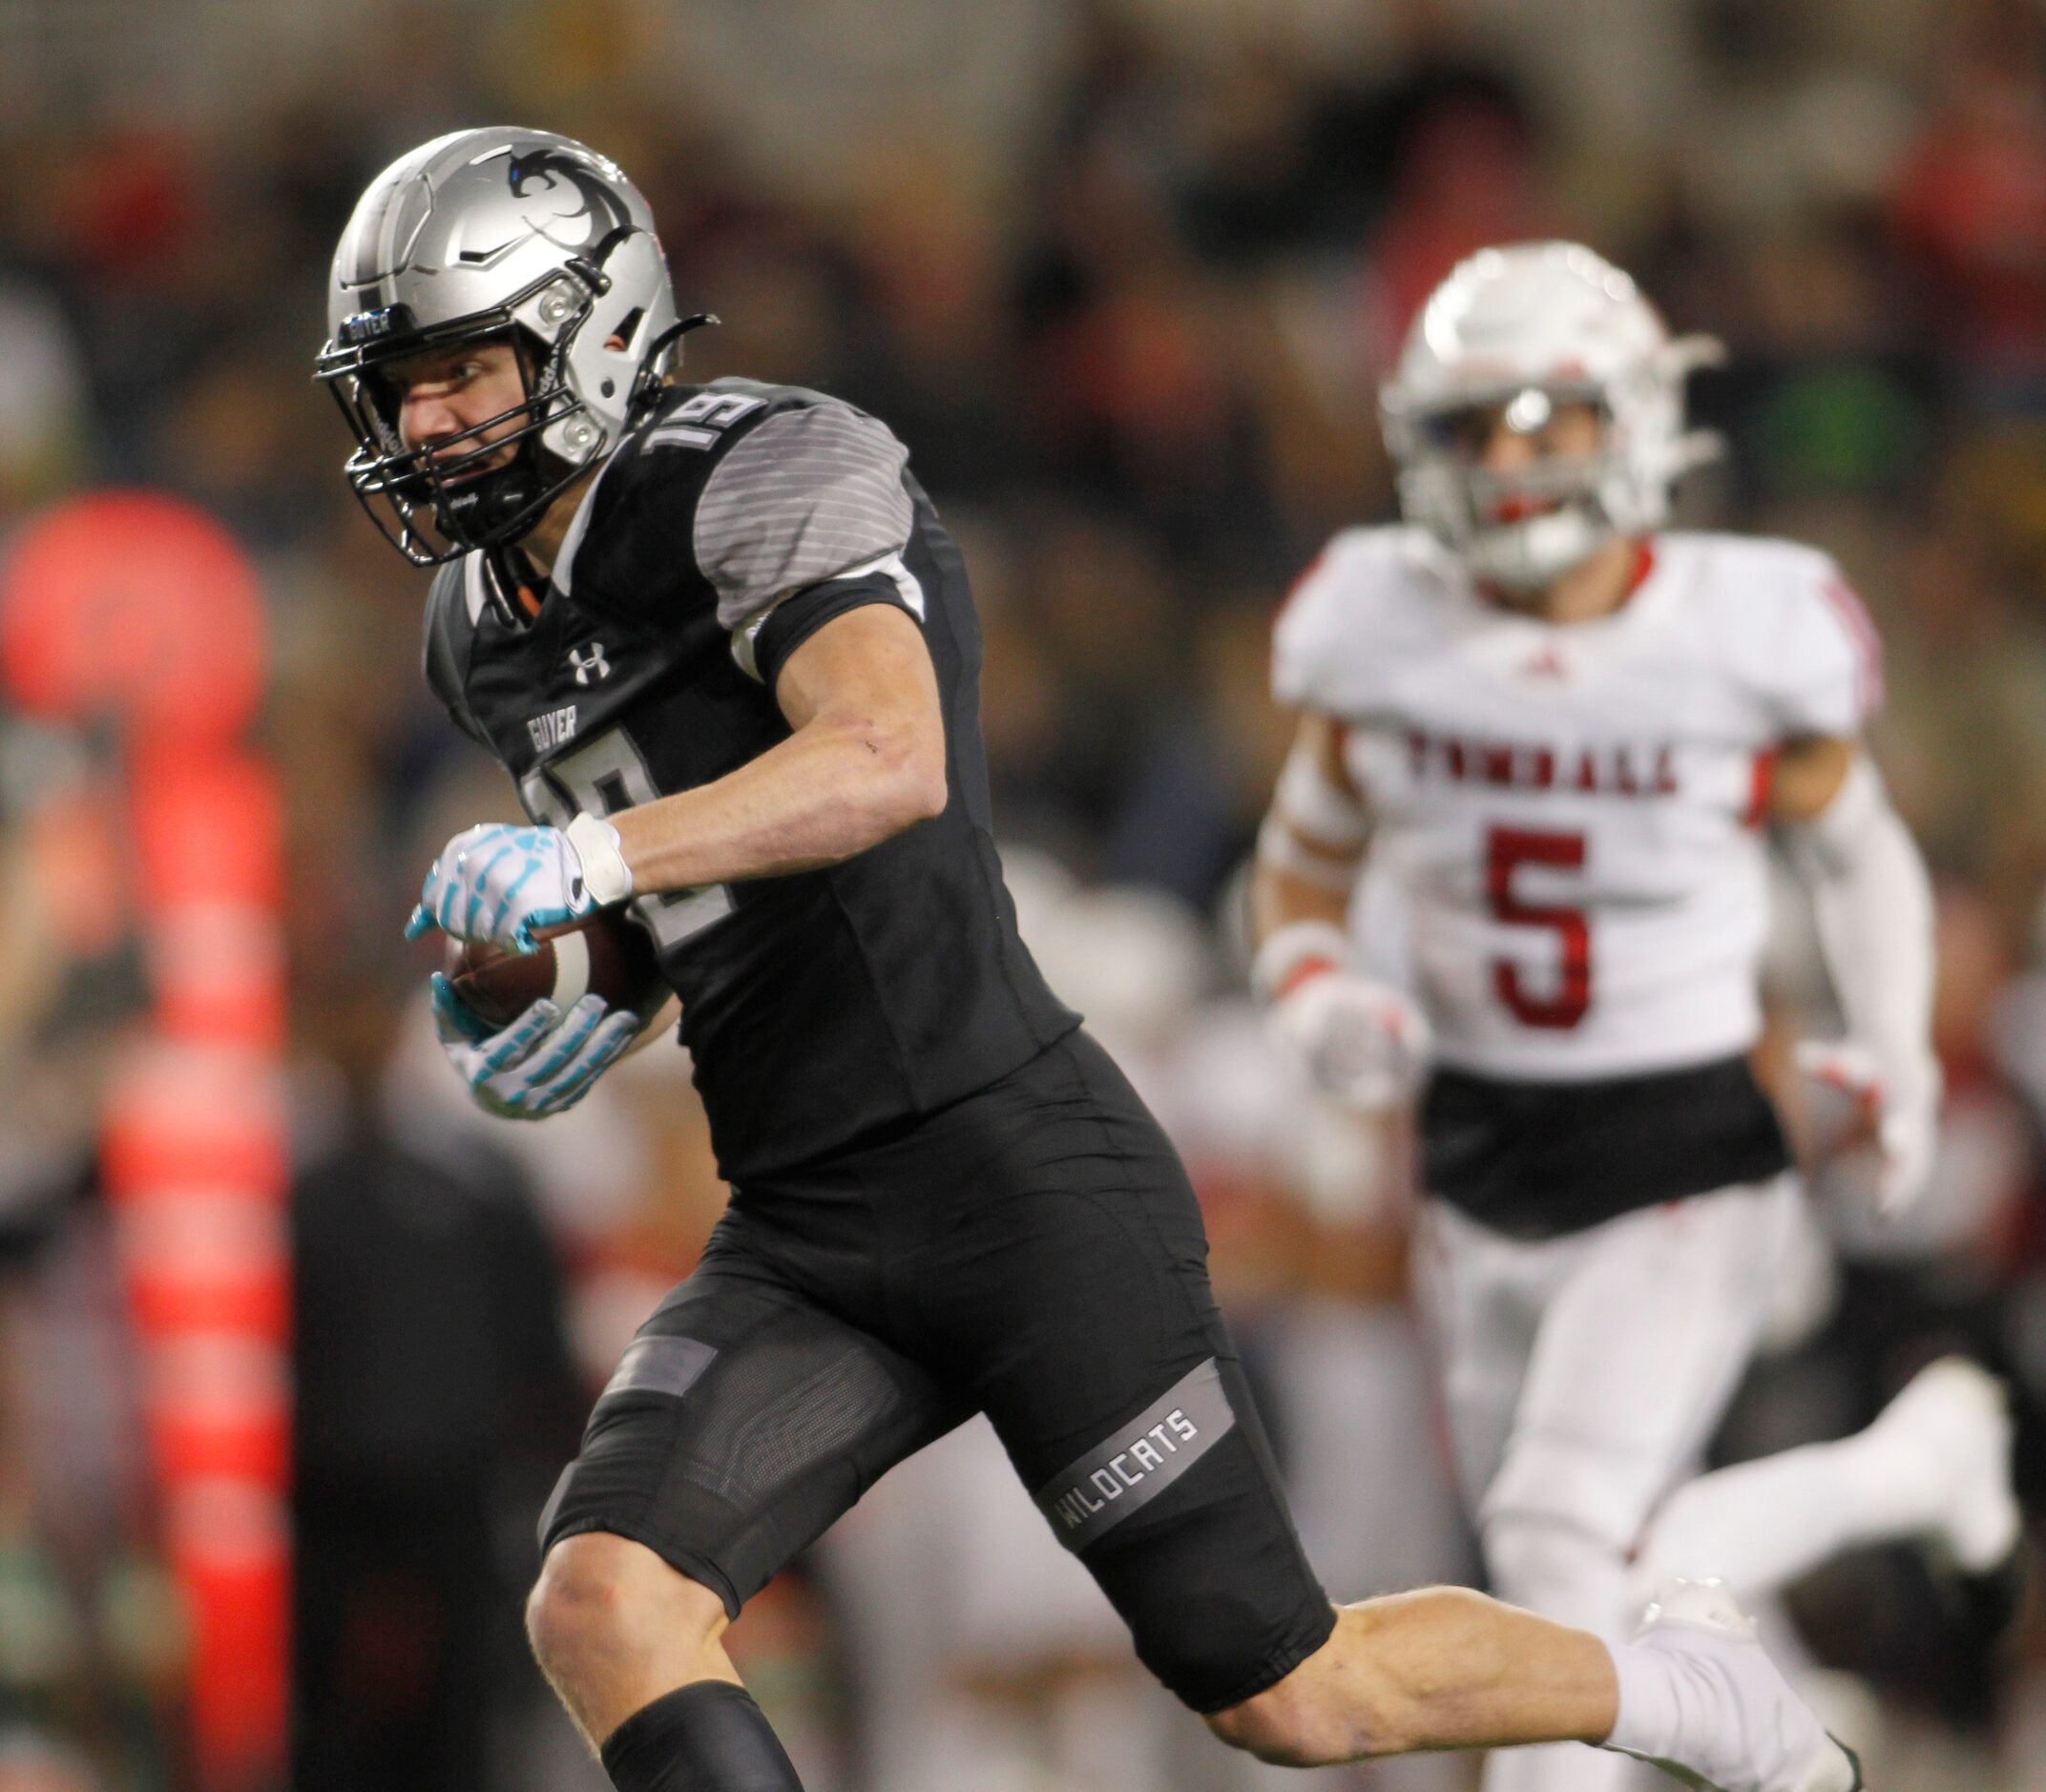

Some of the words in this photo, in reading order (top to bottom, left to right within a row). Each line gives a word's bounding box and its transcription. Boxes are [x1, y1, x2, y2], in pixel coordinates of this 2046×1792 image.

[640, 392, 768, 456] 19
[527, 704, 576, 753] GUYER
[1487, 826, 1590, 1031] 5
[1055, 1407, 1199, 1529] WILDCATS
